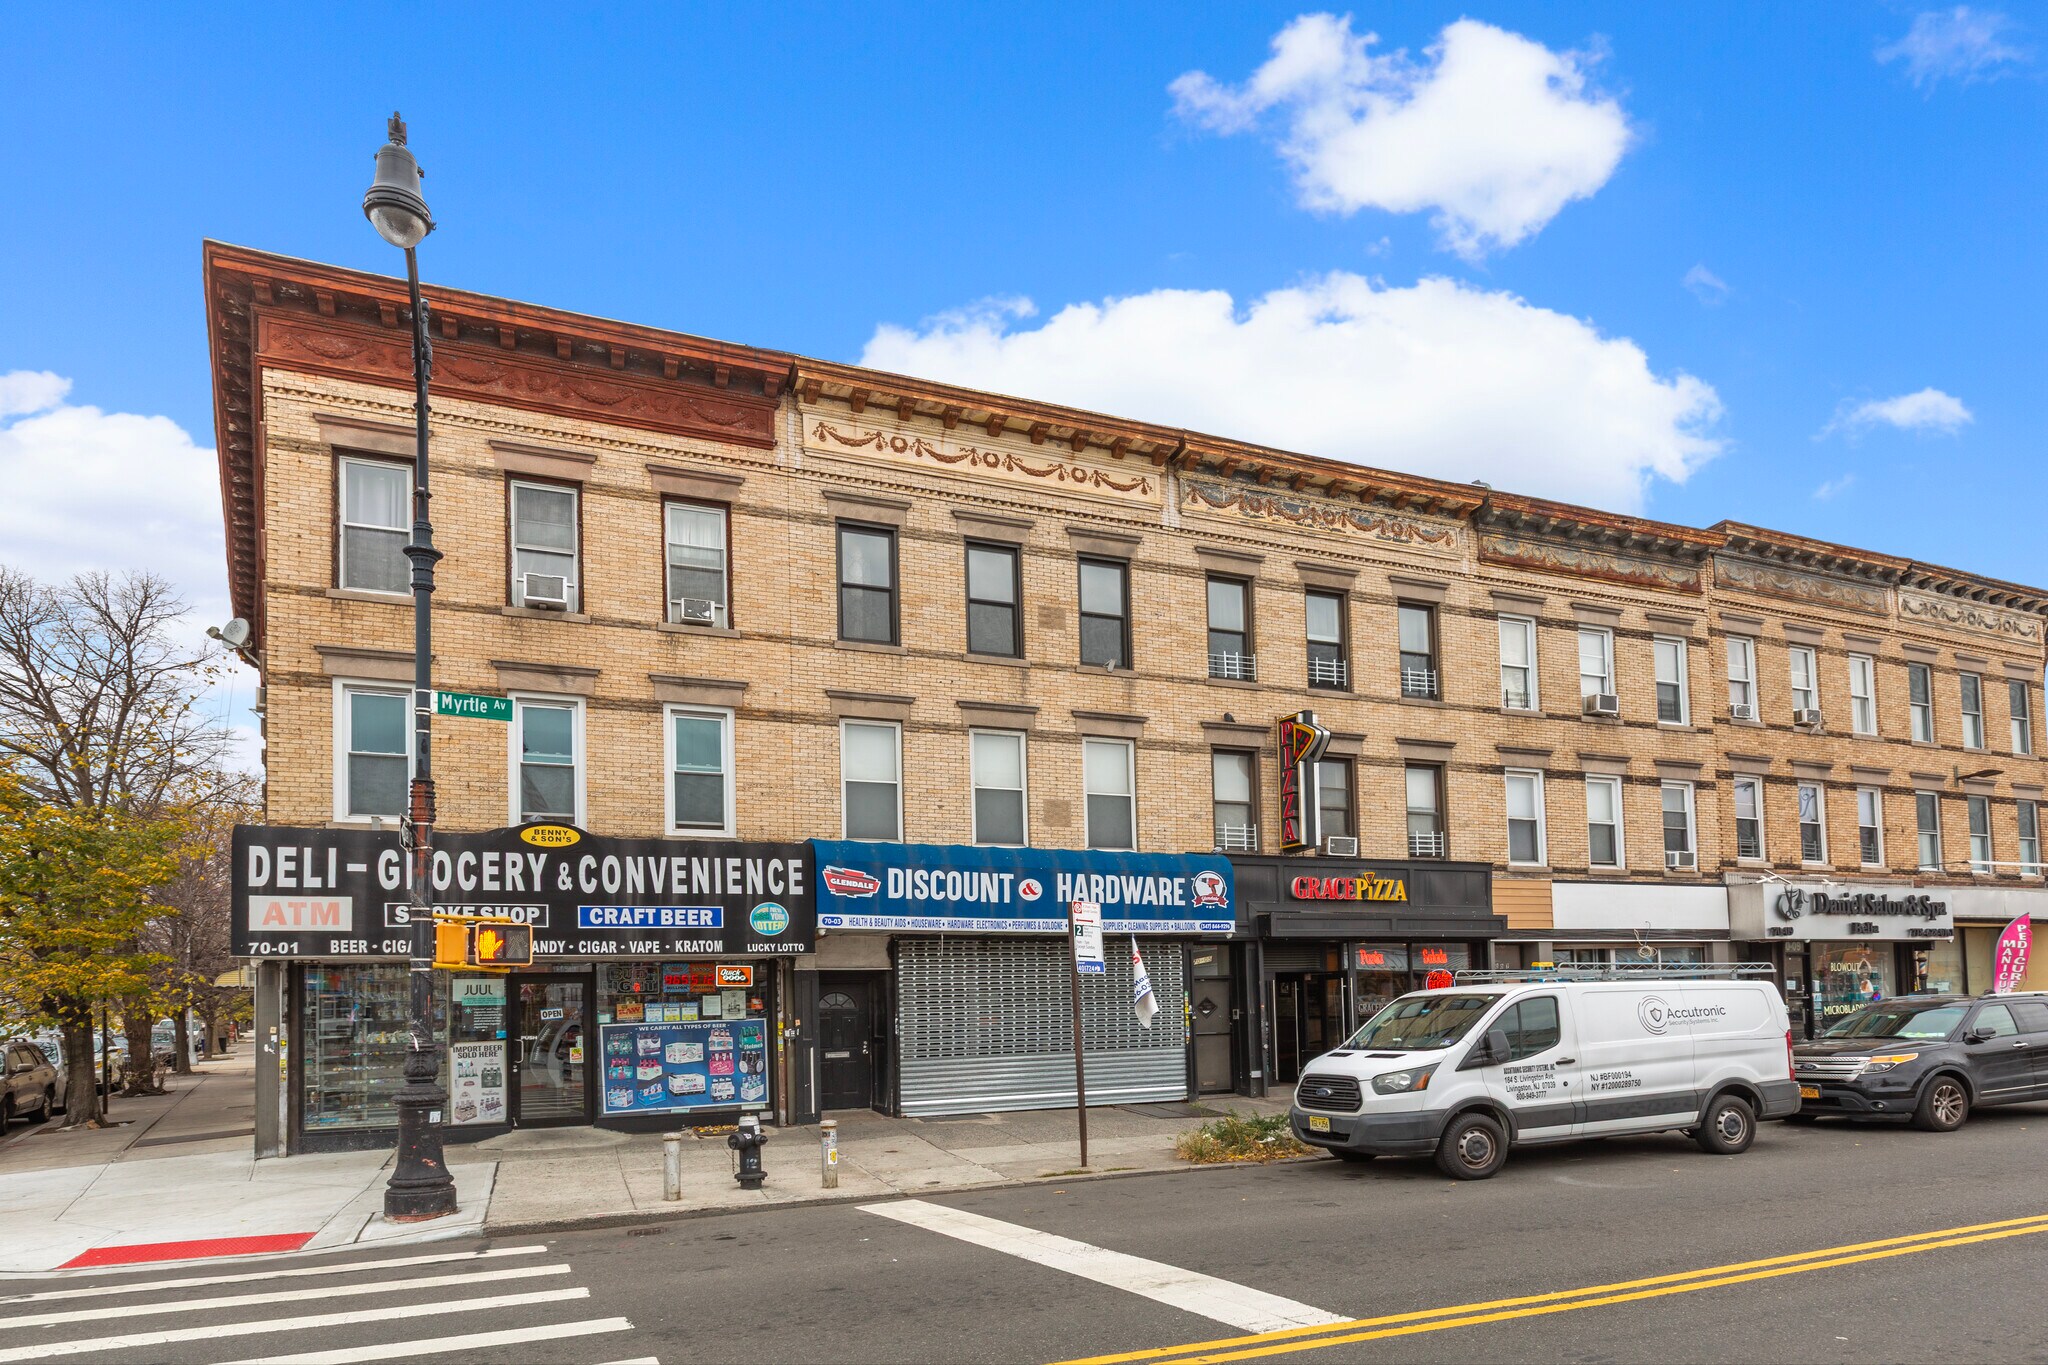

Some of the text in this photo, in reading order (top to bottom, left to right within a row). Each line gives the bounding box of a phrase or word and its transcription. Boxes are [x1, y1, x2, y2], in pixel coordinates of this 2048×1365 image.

[441, 694, 506, 714] Myrtle Av
[1280, 721, 1296, 842] PIZZA
[534, 828, 569, 837] BENNY
[541, 836, 572, 844] SON'S
[248, 845, 337, 888] DELI
[578, 855, 804, 896] CONVENIENCE
[830, 878, 874, 890] GLENDALE
[888, 868, 1014, 904] DISCOUNT
[1057, 873, 1186, 906] HARDWARE
[1292, 876, 1356, 900] GRACE
[1813, 892, 1862, 916] Daniel
[1864, 893, 1904, 916] Salon
[1919, 895, 1948, 920] Spa
[262, 901, 340, 926] ATM
[394, 906, 475, 924] SOKE
[589, 908, 714, 926] CRAFT BEER
[848, 917, 868, 926] HEALTH
[874, 918, 894, 927] BEAUTY
[894, 918, 906, 928] AIDS
[911, 919, 942, 928] HOUSEWARE
[947, 920, 974, 929] HARDWARE
[976, 920, 1008, 930] ELECTRONICS
[1012, 920, 1036, 930] PERFUMES
[1042, 921, 1062, 930] COLOGNE
[1102, 922, 1196, 931] SUPPLIES CLEANING SUPPLIES BALLOONS
[1076, 926, 1082, 936] 2
[248, 942, 299, 954] 70-01
[330, 940, 368, 954] BEER
[532, 940, 566, 954] ANDY
[578, 940, 617, 954] CIGAR
[629, 940, 660, 954] VAPE
[675, 940, 723, 953] KRATOM
[747, 943, 804, 952] LUCKY LOTTO
[2009, 924, 2028, 989] PEDICURE
[464, 984, 493, 996] JUUL
[542, 1010, 562, 1018] OPEN
[1667, 1004, 1726, 1018] Accutronic
[1520, 1074, 1544, 1083] Livingston
[1590, 1074, 1598, 1082] NJ
